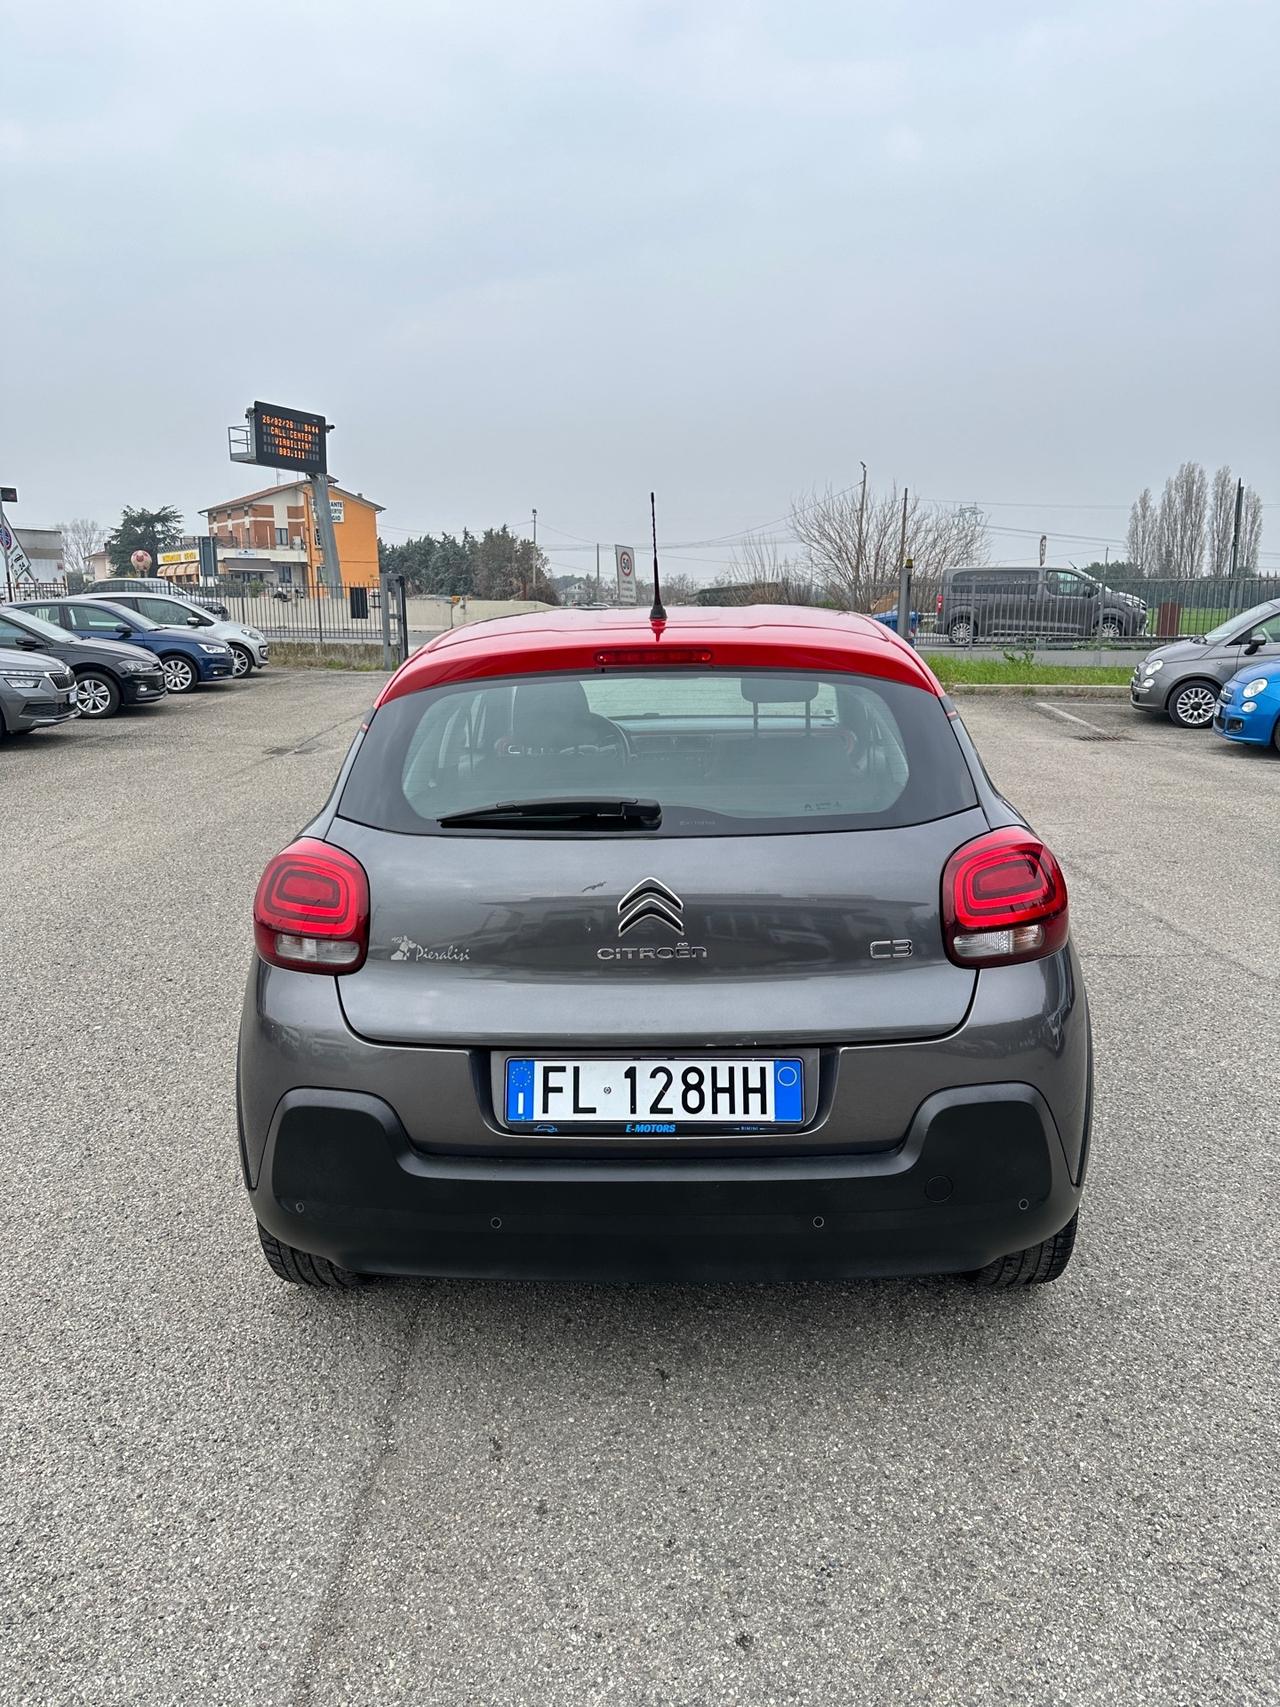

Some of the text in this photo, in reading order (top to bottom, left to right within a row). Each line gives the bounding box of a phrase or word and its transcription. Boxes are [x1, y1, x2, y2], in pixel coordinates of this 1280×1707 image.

[271, 427, 312, 442] CALL CENTER
[415, 945, 471, 962] Pieralisi
[870, 939, 913, 959] C3
[542, 1066, 768, 1115] FL 128HH
[625, 1123, 676, 1133] E-MOTORS
